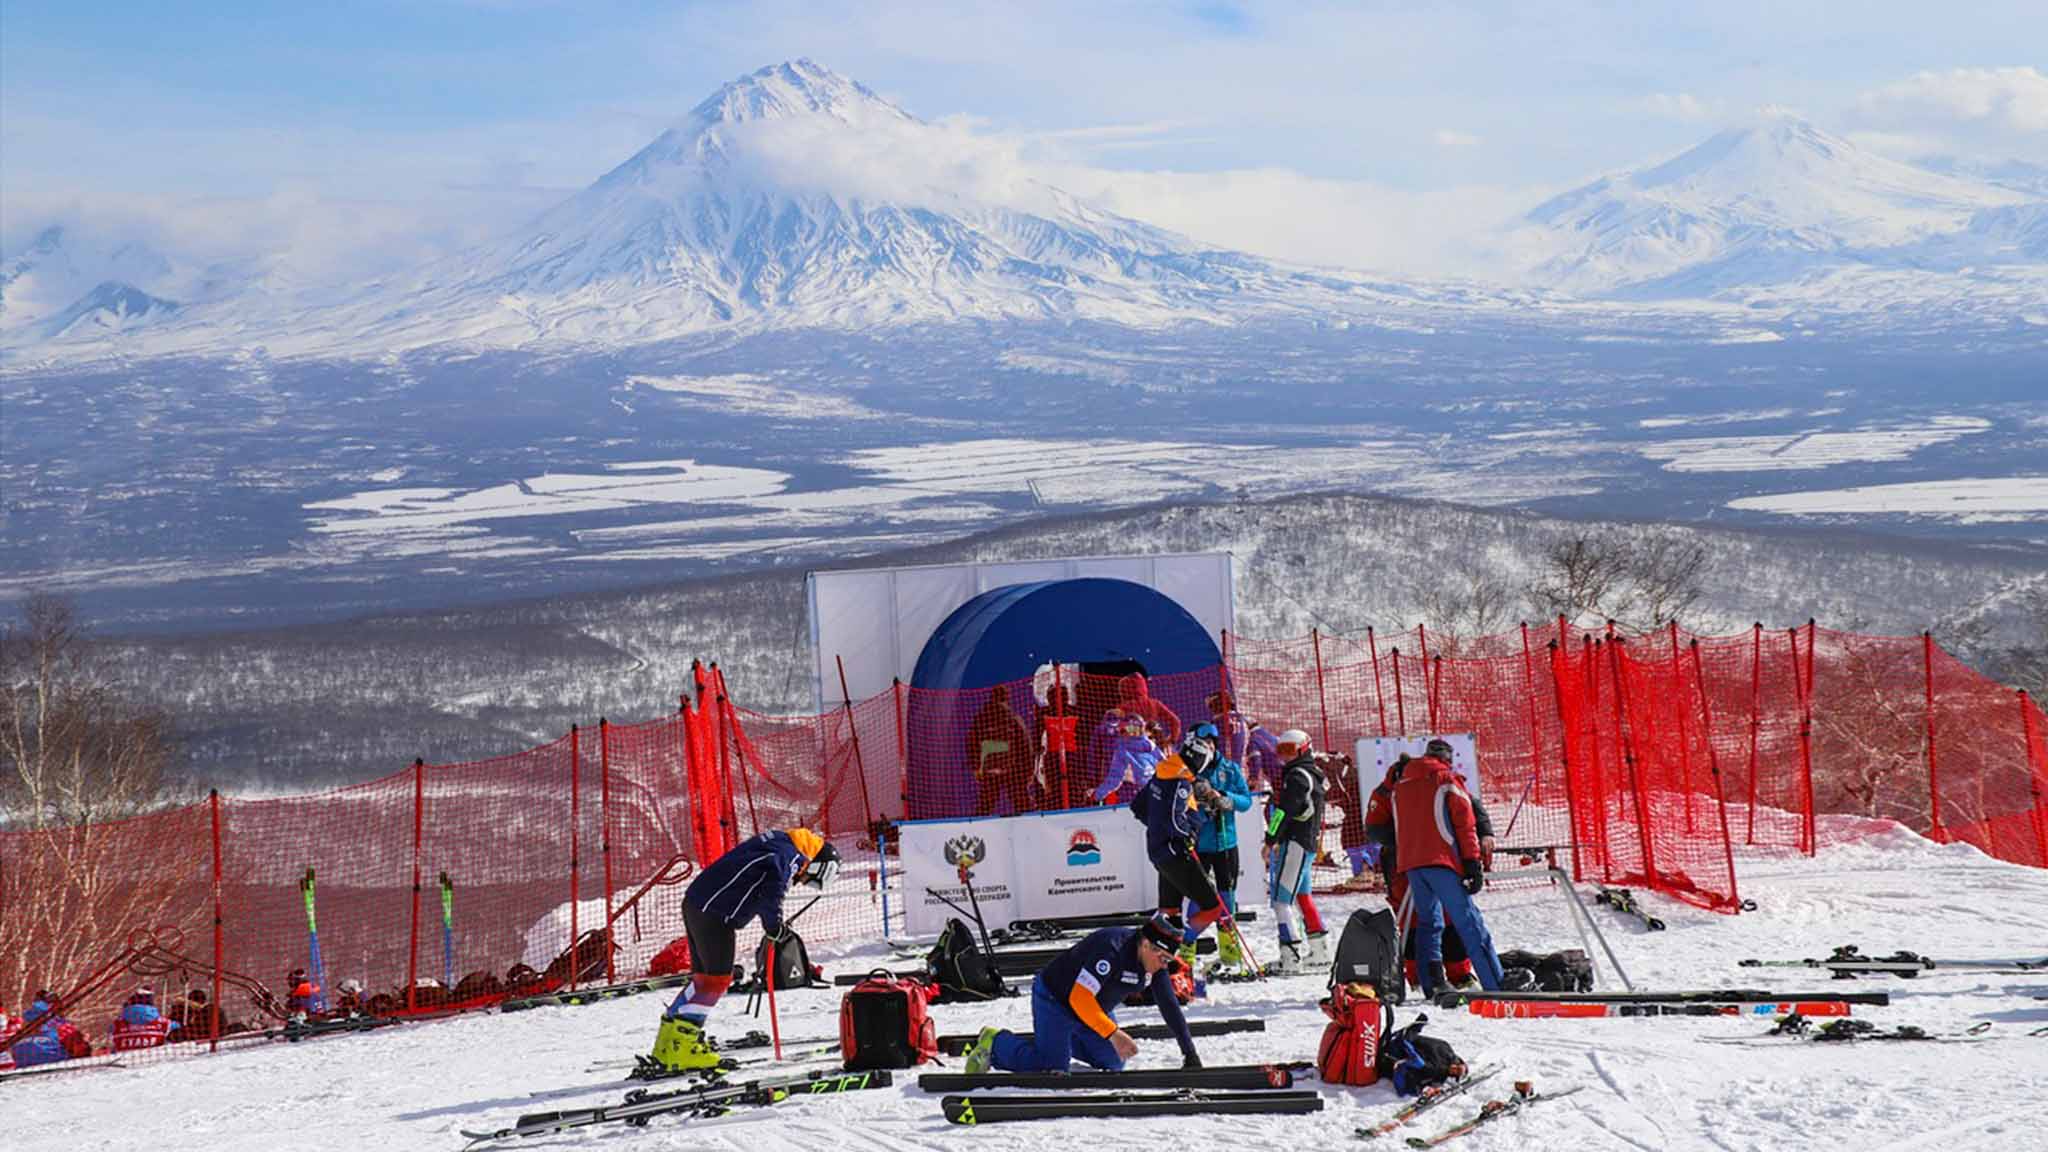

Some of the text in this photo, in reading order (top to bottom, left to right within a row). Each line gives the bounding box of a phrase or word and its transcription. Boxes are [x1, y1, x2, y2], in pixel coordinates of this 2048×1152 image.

[1054, 876, 1117, 887] Правительство
[982, 884, 1008, 893] СПОРТА
[1048, 883, 1124, 896] Камчатского края
[970, 893, 1011, 903] ЕДЕРАЦИИ
